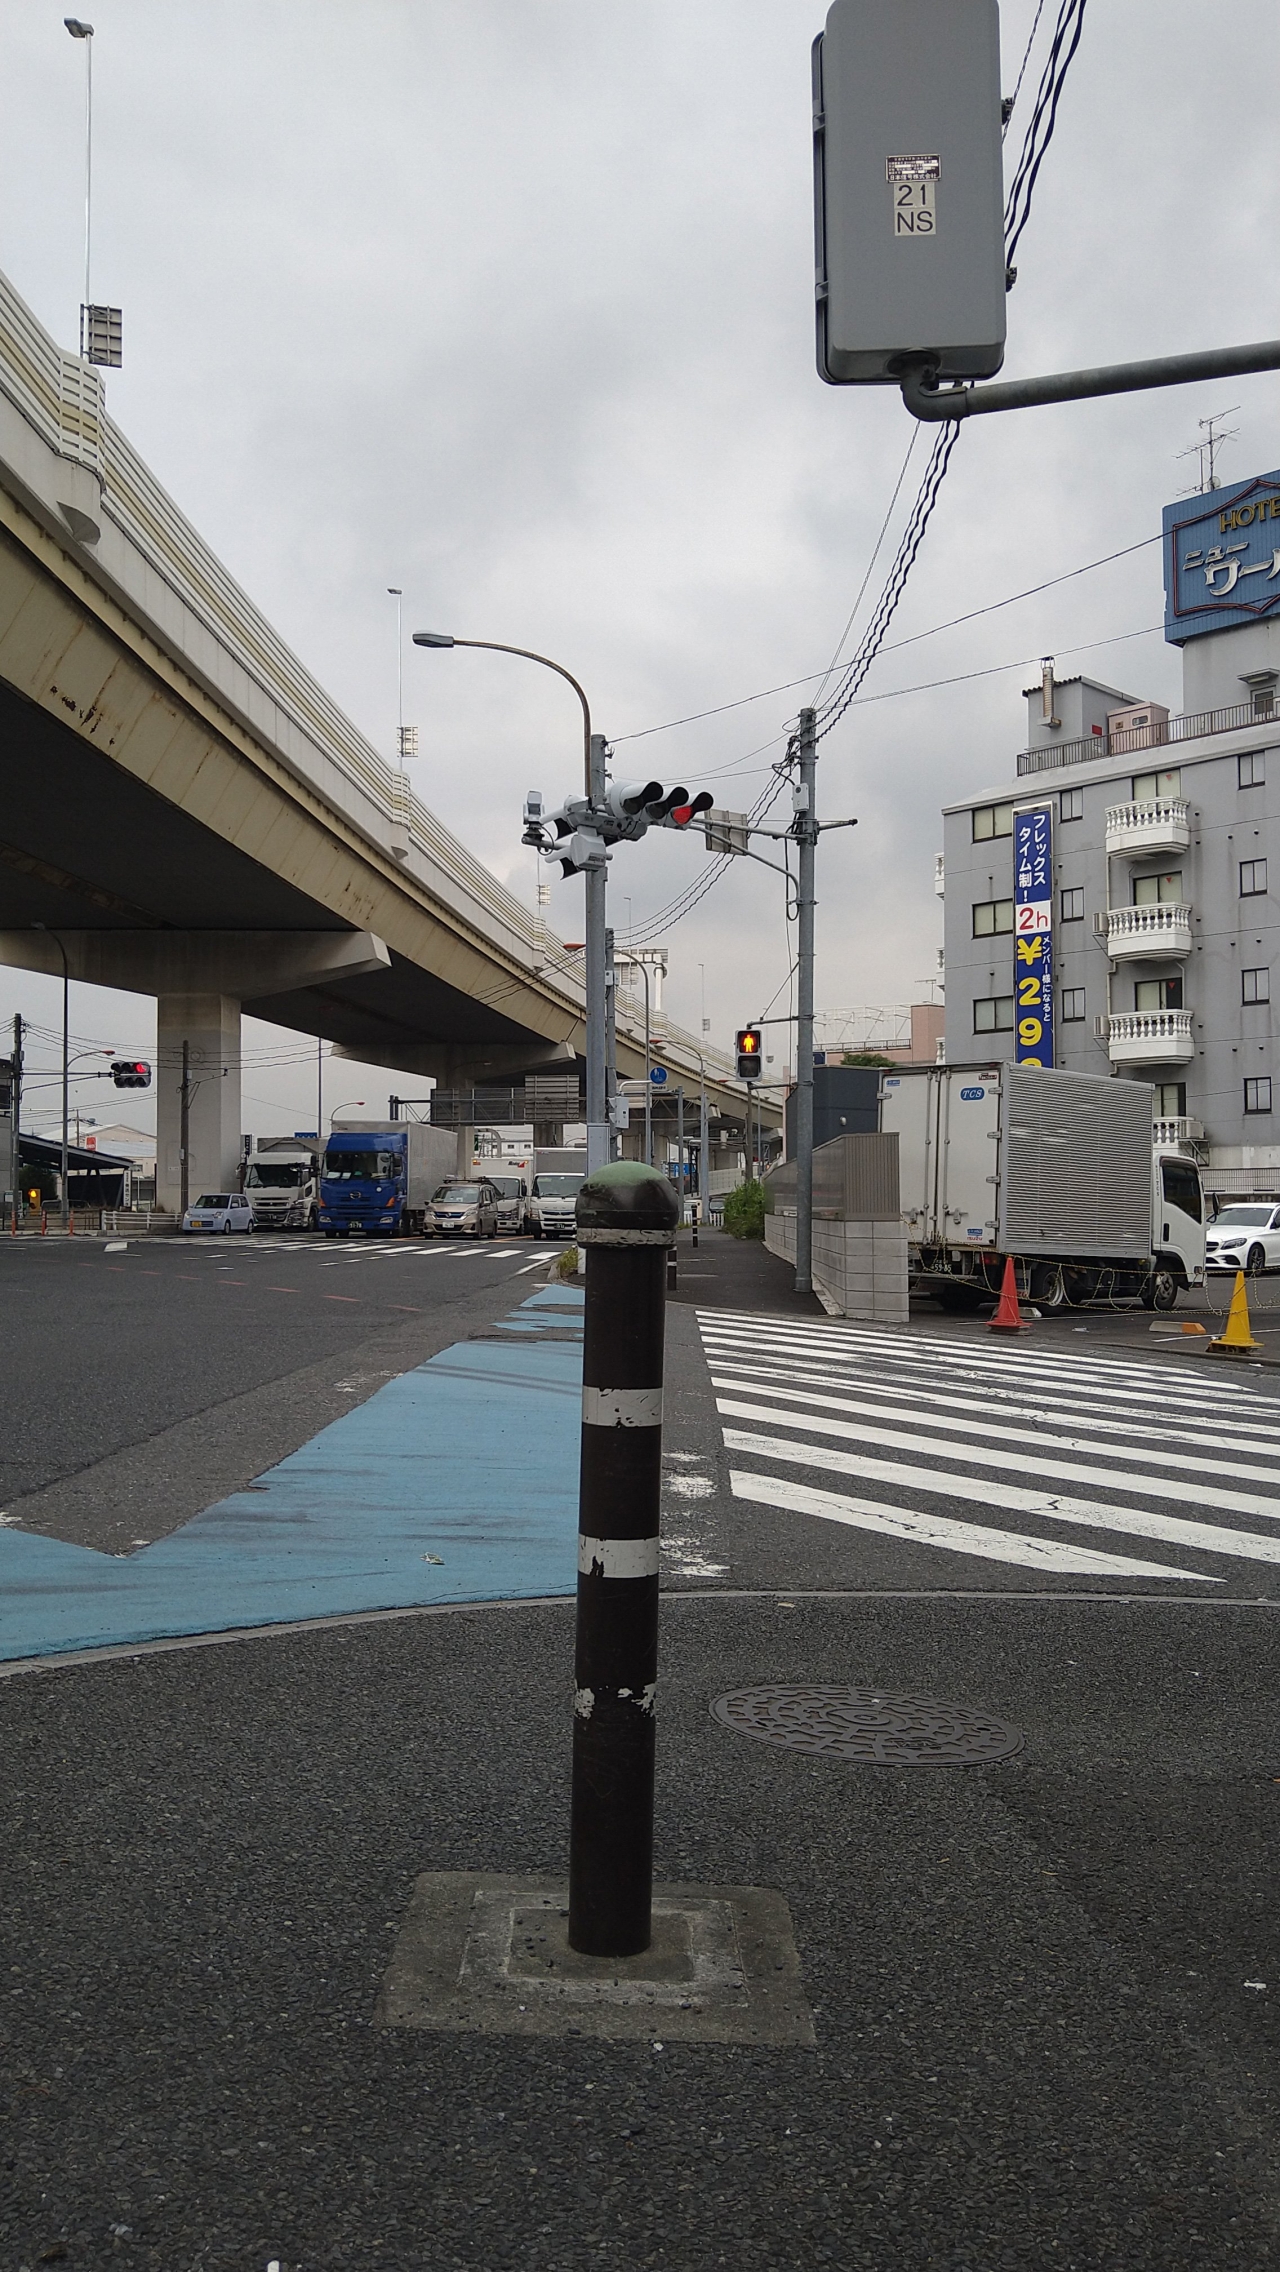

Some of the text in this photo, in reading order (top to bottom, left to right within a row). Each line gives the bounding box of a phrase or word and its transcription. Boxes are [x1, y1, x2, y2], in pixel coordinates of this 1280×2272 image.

[897, 184, 926, 206] 21
[897, 211, 933, 233] NS
[1182, 541, 1249, 570] ニュー
[1018, 826, 1032, 902] タイム制！
[1033, 814, 1046, 885] フレックス
[1018, 907, 1048, 931] 2h
[1042, 936, 1051, 1022] メンバー様になると
[1017, 936, 1043, 1067] ¥29
[962, 1089, 983, 1099] TCS
